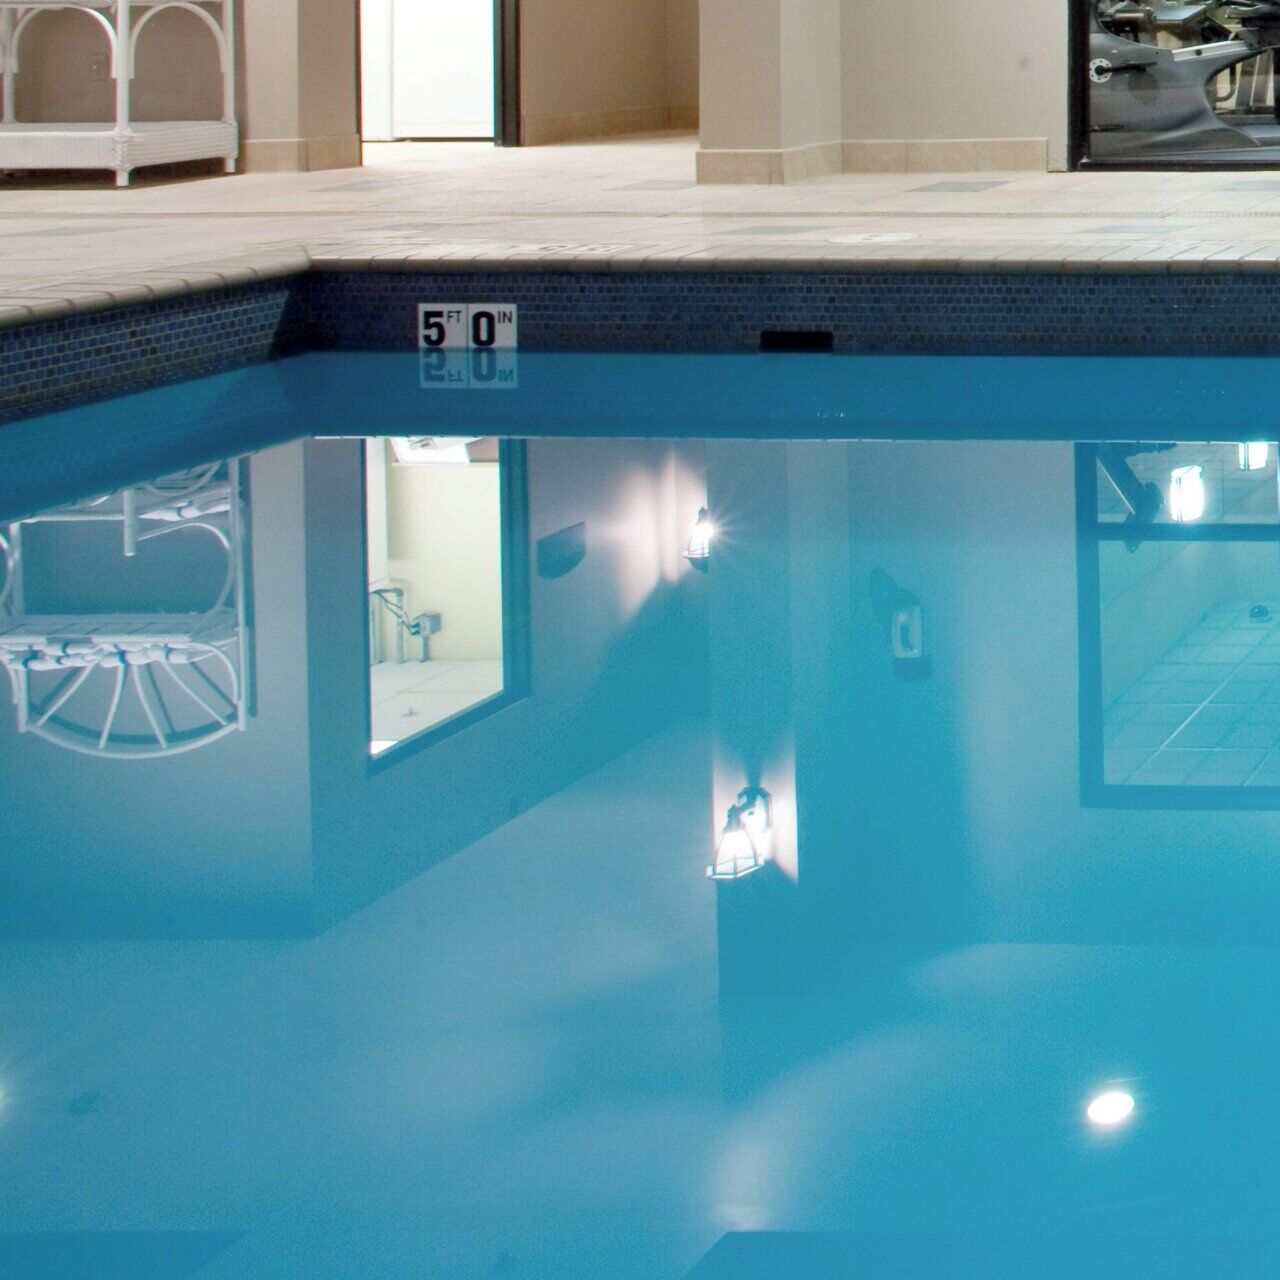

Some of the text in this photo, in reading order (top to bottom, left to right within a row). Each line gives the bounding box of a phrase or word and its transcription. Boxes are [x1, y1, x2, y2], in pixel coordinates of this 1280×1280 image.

[423, 310, 513, 346] 5 FT 0 IN
